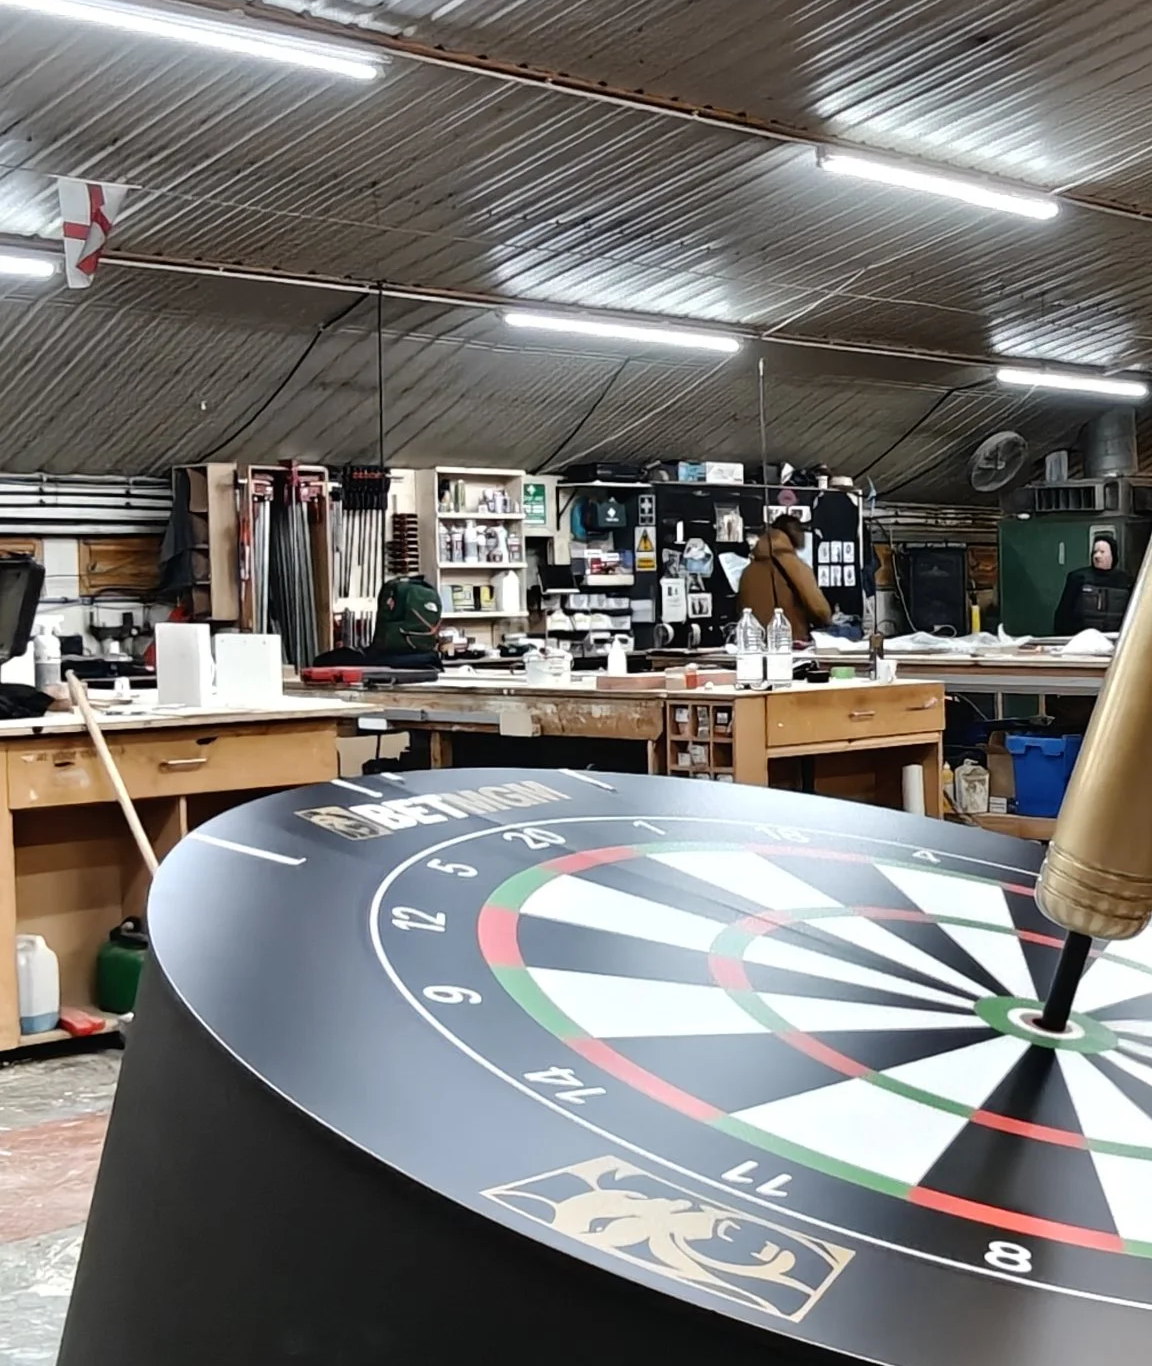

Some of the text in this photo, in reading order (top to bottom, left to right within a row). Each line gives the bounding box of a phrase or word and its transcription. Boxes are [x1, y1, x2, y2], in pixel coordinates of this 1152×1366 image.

[349, 780, 572, 830] BETMGM
[503, 827, 566, 850] 20
[633, 819, 666, 835] 1
[427, 858, 478, 877] 5
[912, 849, 941, 863] 4
[391, 906, 446, 932] 12
[422, 985, 482, 1004] 9
[523, 1066, 606, 1104] 14
[721, 1160, 792, 1197] 11
[984, 1241, 1032, 1272] 8
